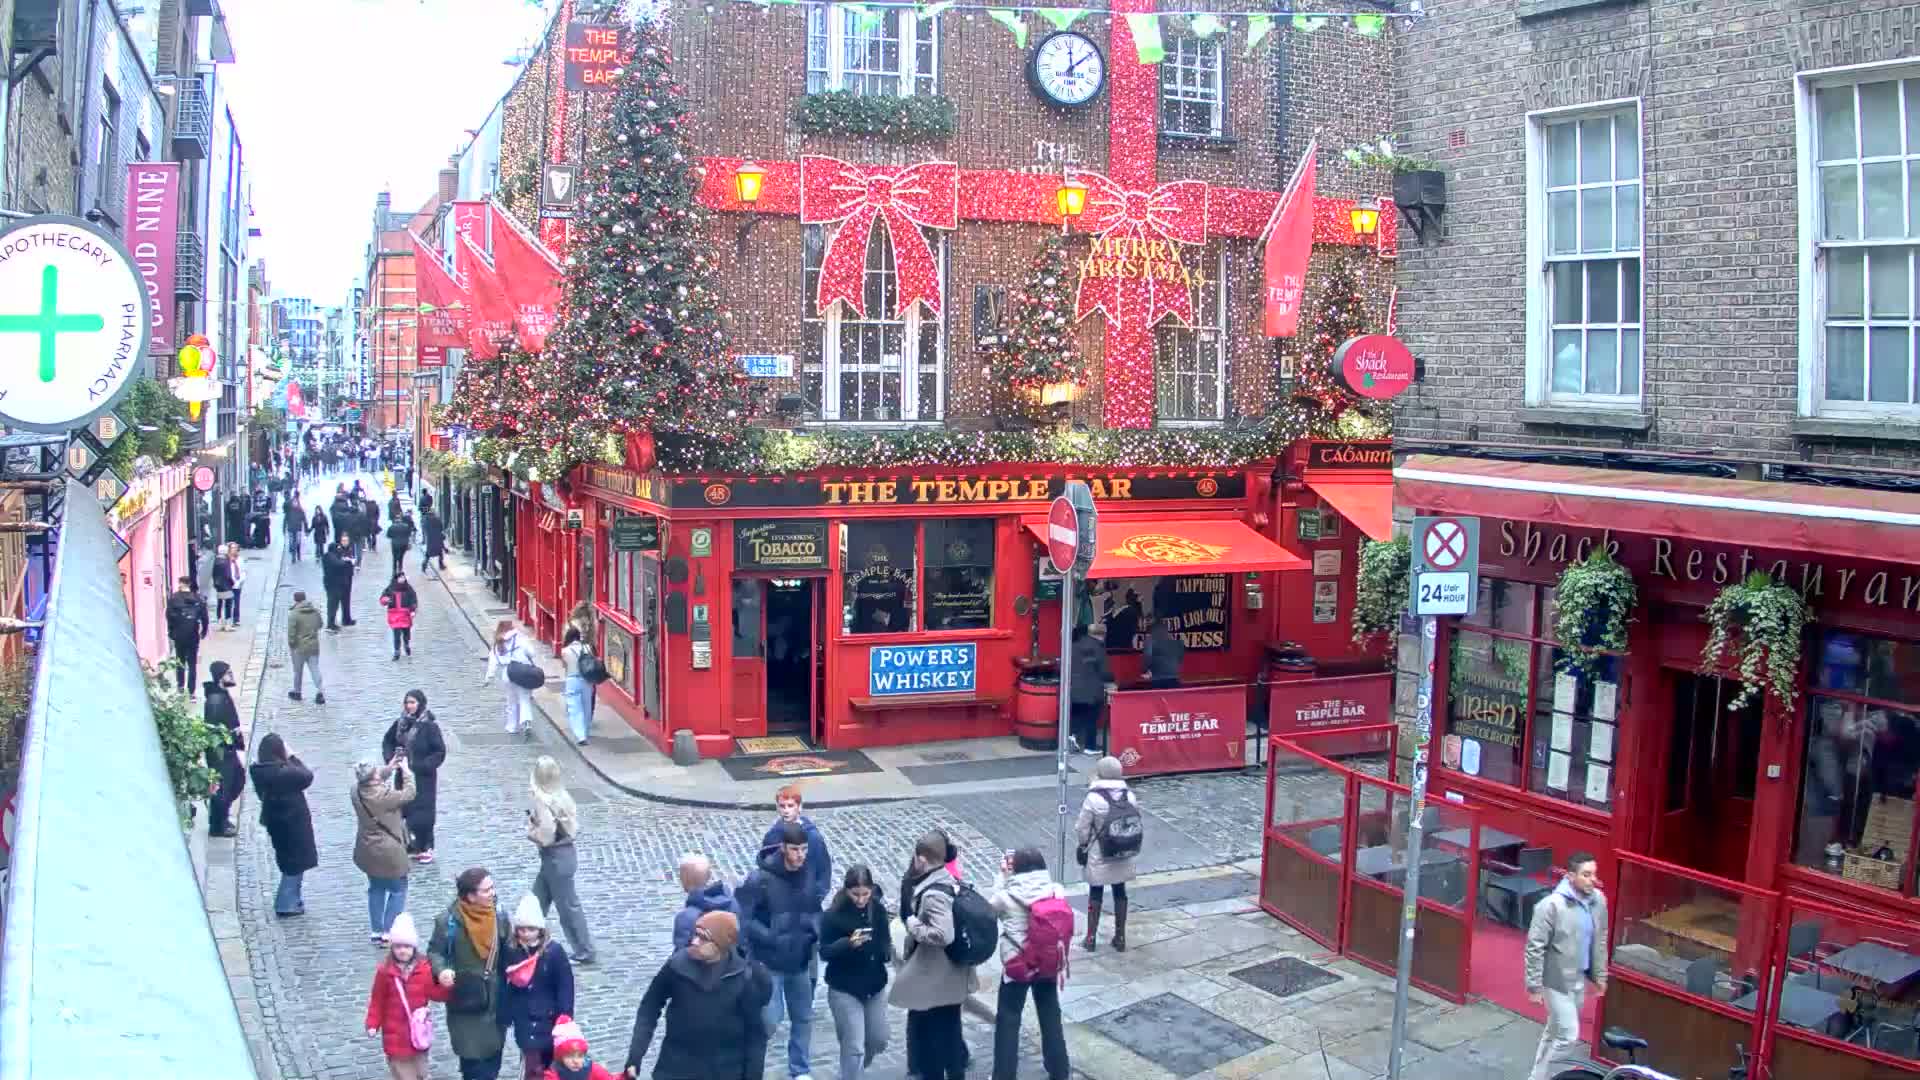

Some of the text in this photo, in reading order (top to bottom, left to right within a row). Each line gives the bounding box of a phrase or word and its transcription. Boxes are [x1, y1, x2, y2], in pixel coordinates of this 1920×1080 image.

[583, 29, 617, 45] THE
[567, 47, 632, 65] TEMPLE
[134, 171, 169, 232] NINE
[0, 232, 113, 267] APOTHECARY
[1087, 236, 1184, 262] MERRY
[87, 303, 136, 401] PHARMACY
[1356, 347, 1387, 374] Shack
[635, 476, 652, 500] BAR
[823, 481, 897, 503] THE
[911, 479, 1049, 502] TEMPLE
[749, 538, 816, 561] TOBACCO
[1500, 519, 1620, 567] Shack
[1175, 578, 1225, 593] EMPEROR
[1421, 584, 1442, 602] 24
[1211, 593, 1225, 608] OF
[1443, 594, 1465, 602] HOUR
[1132, 631, 1225, 650] GNNESS
[879, 647, 968, 668] POWER'S
[873, 670, 972, 690] WHISKEY
[1296, 705, 1366, 721] TEMPLE BAR
[1323, 700, 1341, 708] THE
[1169, 712, 1190, 721] THE
[1140, 719, 1219, 735] TEMPLE BAR
